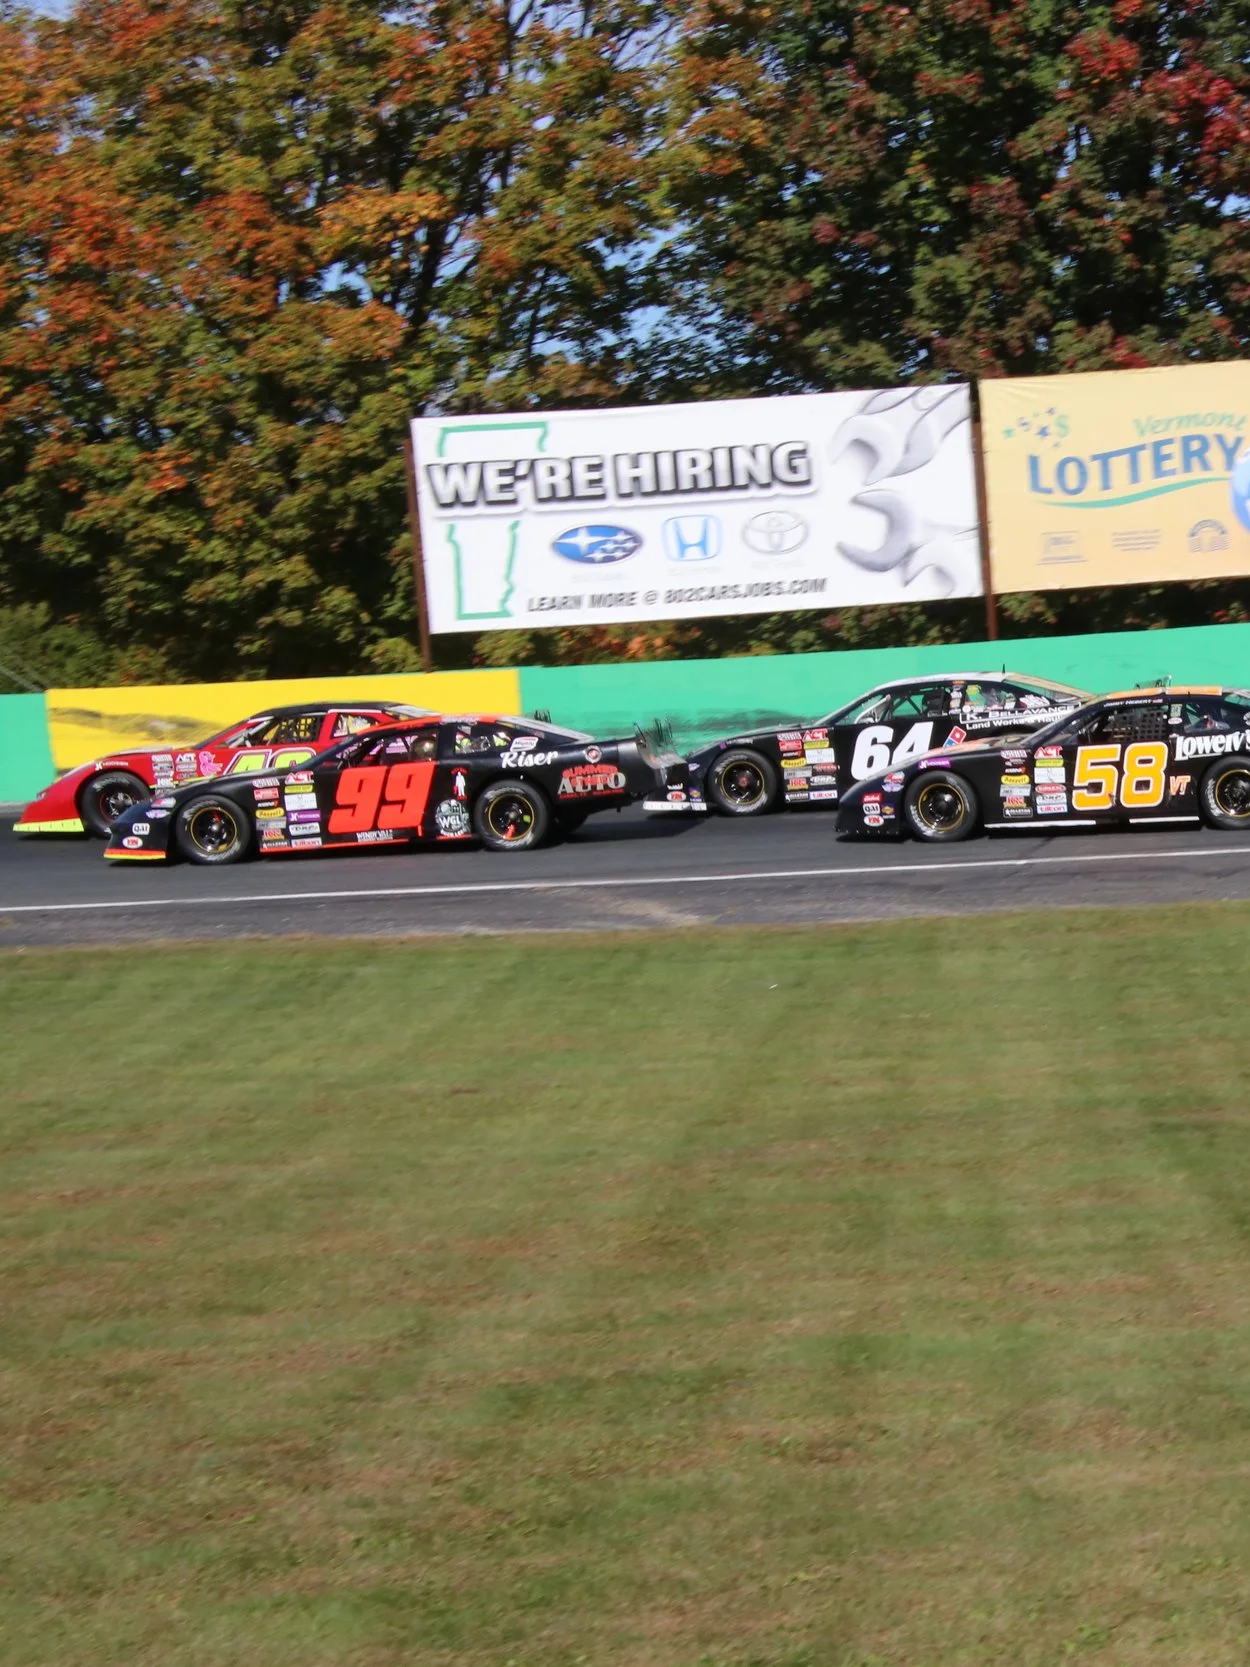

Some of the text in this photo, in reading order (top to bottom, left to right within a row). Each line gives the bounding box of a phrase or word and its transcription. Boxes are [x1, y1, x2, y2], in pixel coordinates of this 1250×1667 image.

[1132, 408, 1248, 437] Vermont
[425, 440, 813, 511] WE'RE HIRING
[1029, 433, 1246, 496] LOTTERY
[529, 577, 828, 613] LEARN MORE @ 802CARSJOBS.COM
[966, 712, 981, 721] K.
[966, 720, 991, 730] Land
[996, 717, 1021, 726] Works
[802, 728, 829, 742] ACT
[850, 720, 935, 782] 64
[500, 750, 559, 769] Riser
[557, 772, 626, 796] AUTO
[1072, 742, 1191, 810] 58 VT
[328, 762, 438, 834] 99
